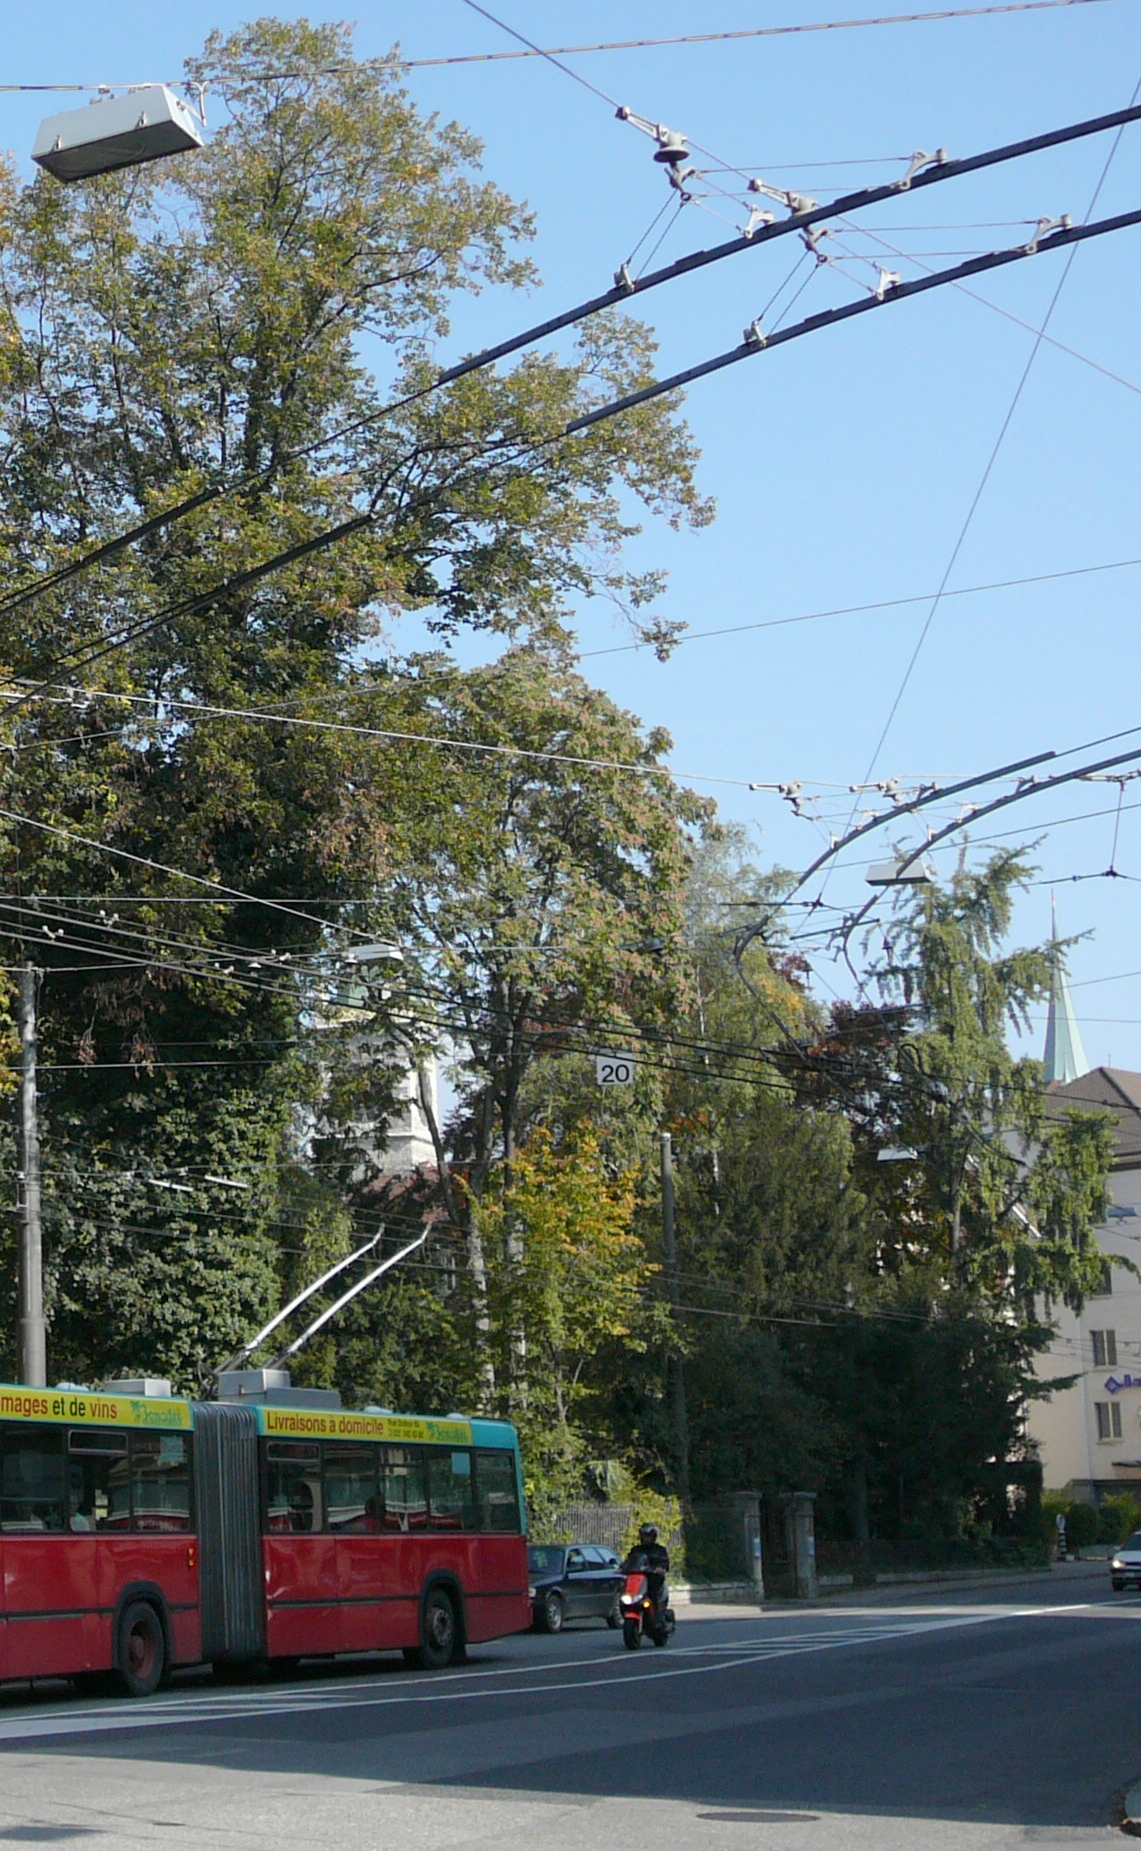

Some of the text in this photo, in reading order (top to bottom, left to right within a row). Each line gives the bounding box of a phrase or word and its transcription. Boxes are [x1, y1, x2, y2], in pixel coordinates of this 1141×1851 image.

[601, 1064, 630, 1083] 20
[52, 1397, 65, 1416] et
[69, 1397, 86, 1417] de
[90, 1401, 118, 1419] vins
[267, 1412, 327, 1432] Livraisons
[329, 1414, 337, 1433] à
[339, 1416, 384, 1435] domicile
